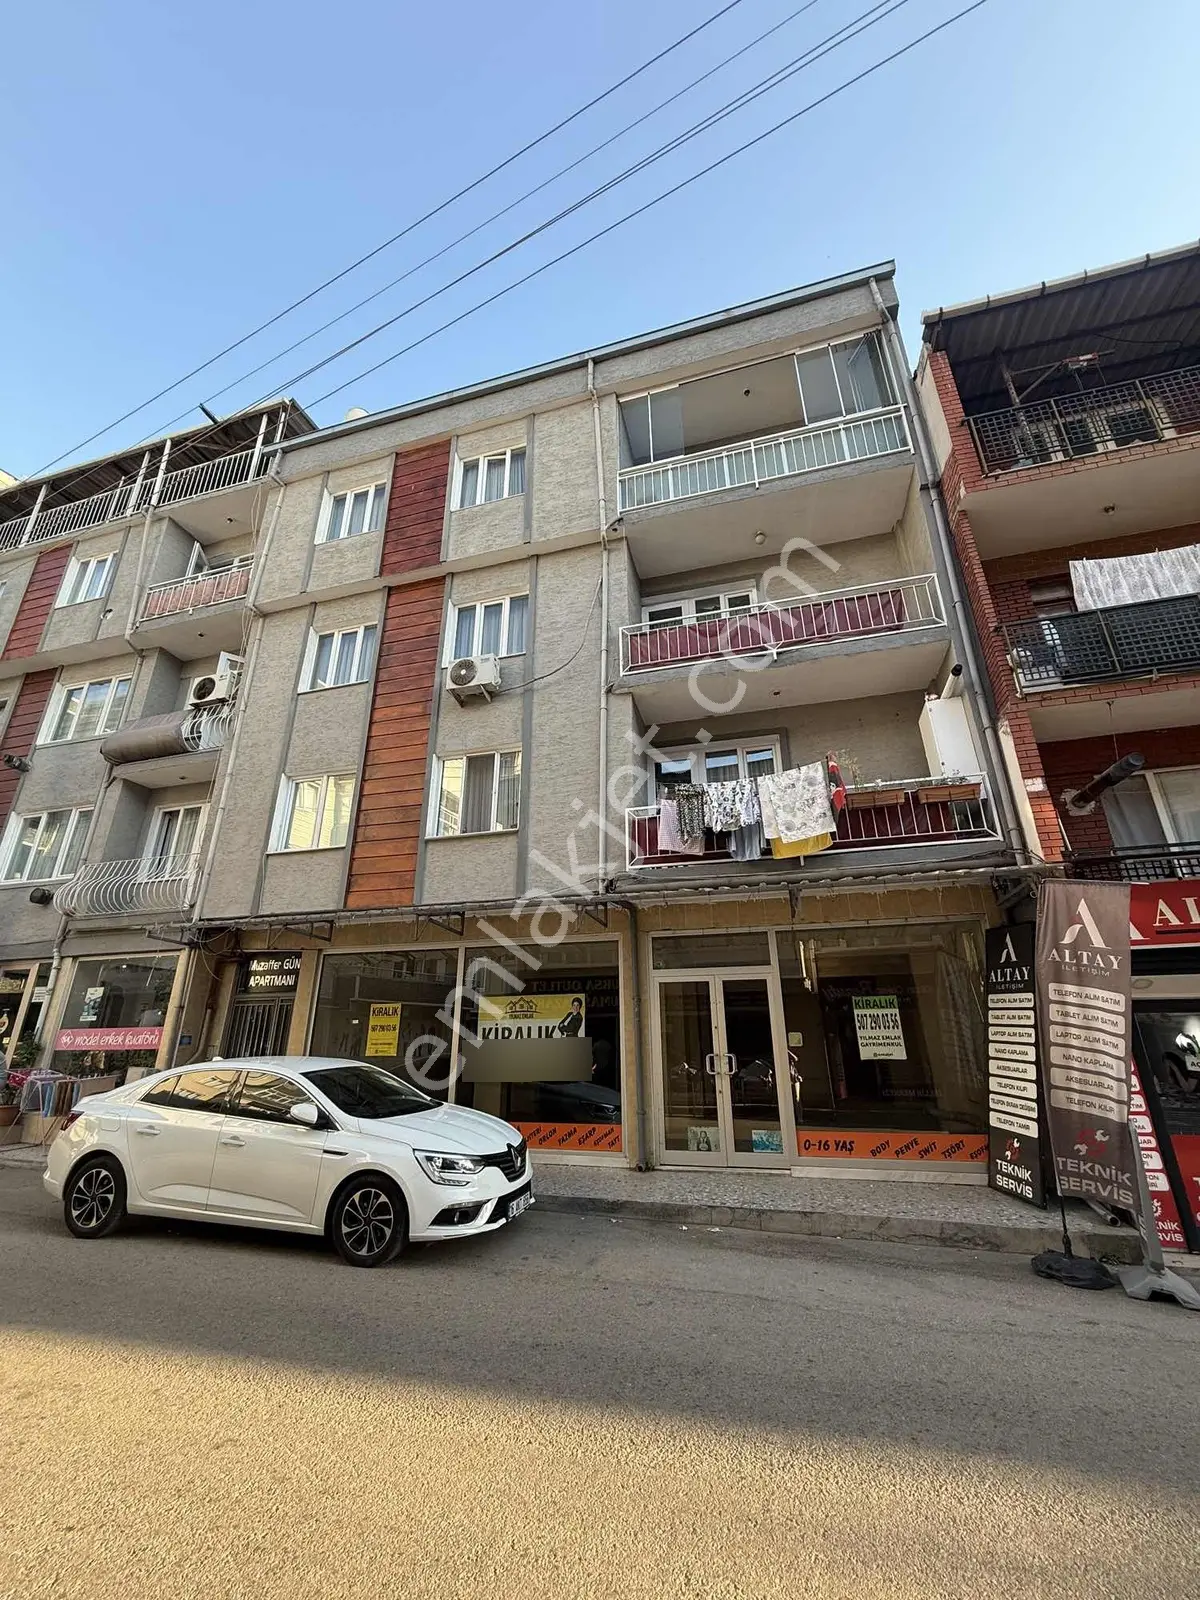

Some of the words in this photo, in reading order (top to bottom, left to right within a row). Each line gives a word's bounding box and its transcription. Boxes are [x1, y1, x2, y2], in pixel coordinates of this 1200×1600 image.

[249, 960, 281, 970] Muzaffer
[284, 956, 301, 970] GÜN
[1048, 948, 1122, 970] ALTAY
[248, 975, 295, 987] APARTMANI
[989, 966, 1030, 982] ALTAY
[854, 998, 896, 1009] KİRALIK
[1053, 989, 1082, 998] TELEFON
[1085, 993, 1100, 1001] ALIM
[1101, 995, 1121, 1006] SATIM
[1056, 1010, 1080, 1020] TABLET
[1082, 1014, 1099, 1022] ALIM
[1101, 1017, 1119, 1028] SATIM
[74, 1032, 100, 1046] model
[101, 1031, 124, 1046] erkek
[1056, 1031, 1082, 1040] LAPTOP
[1084, 1036, 1100, 1044] ALIM
[1101, 1039, 1119, 1050] SATIM
[1063, 1053, 1082, 1064] NANO
[1084, 1056, 1115, 1070] KAPLAMA
[996, 1082, 1016, 1090] TELEFON
[1066, 1096, 1096, 1110] TELEFON
[996, 1116, 1016, 1126] TELEFON
[804, 1139, 830, 1151] 0-16
[834, 1140, 855, 1155] YAŞ
[870, 1140, 891, 1157] BODY
[895, 1138, 920, 1158] PENYE
[996, 1159, 1032, 1182] TEKNİK
[1057, 1157, 1132, 1187] TEKNİK
[996, 1174, 1033, 1199] SERVİS
[1059, 1176, 1134, 1205] SERVİS
